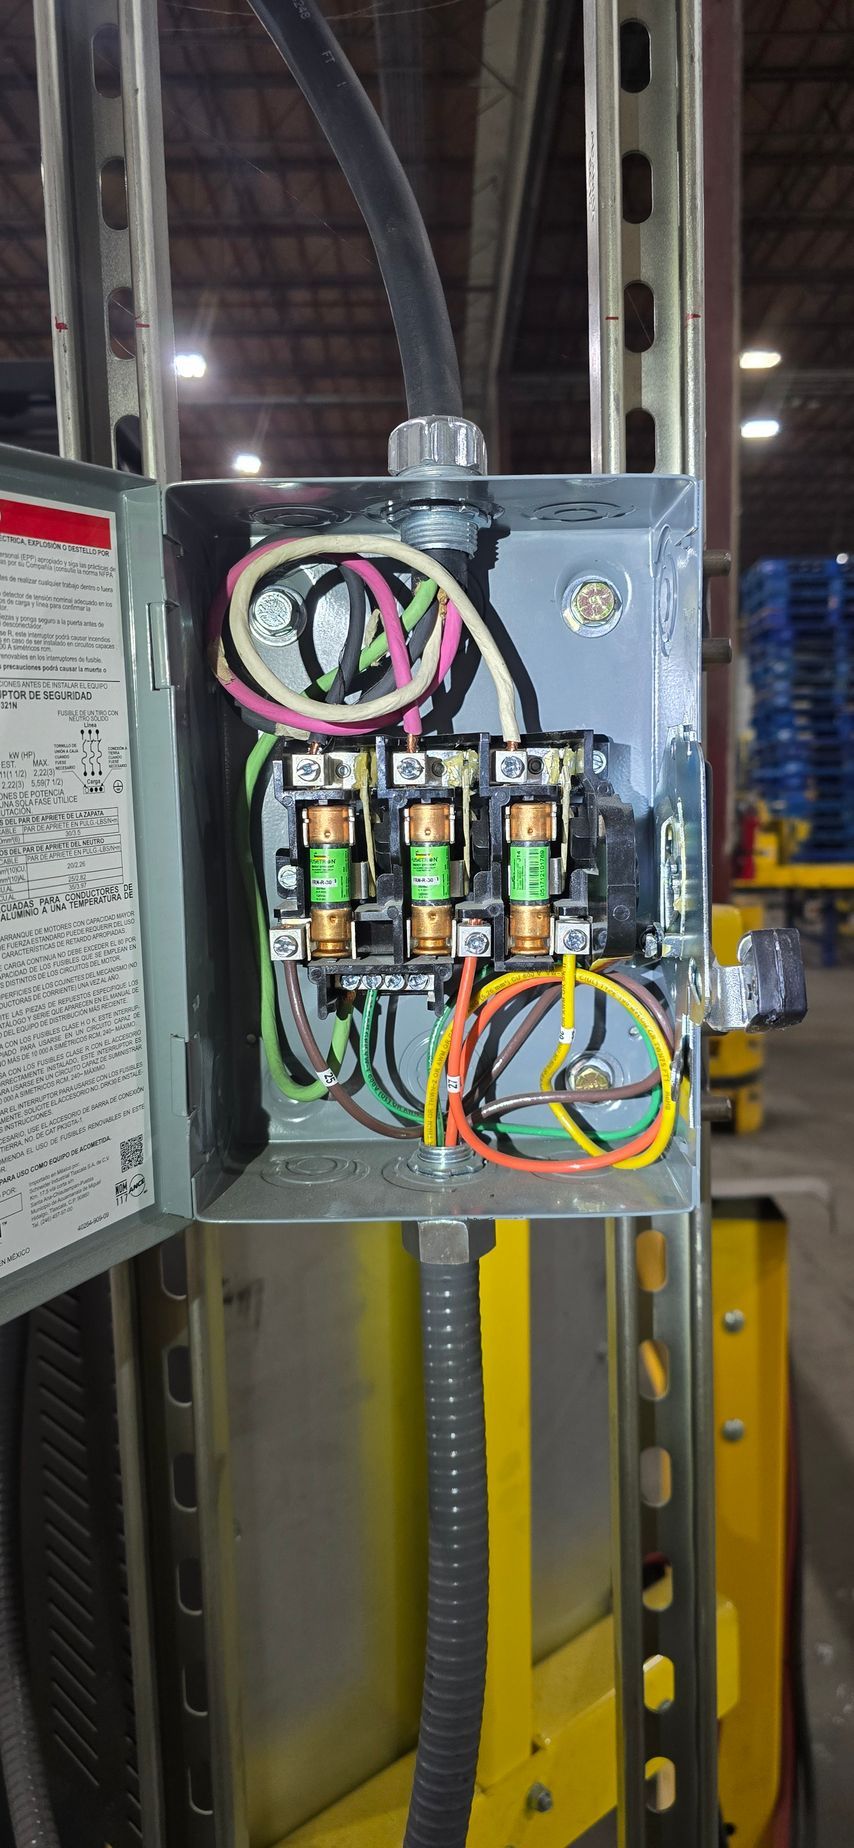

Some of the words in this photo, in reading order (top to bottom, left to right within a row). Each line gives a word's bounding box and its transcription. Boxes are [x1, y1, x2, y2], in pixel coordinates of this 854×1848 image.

[68, 545, 96, 554] DESTELLO
[43, 691, 92, 699] SEGURIDAD
[29, 789, 64, 797] POTENCIA
[0, 900, 34, 912] CUADAS
[40, 895, 60, 905] PARA
[65, 886, 119, 900] CONDUCTORES
[0, 907, 39, 921] ALUMINIO
[51, 902, 66, 912] UNA
[70, 893, 121, 908] TEMPERATURA
[0, 930, 33, 942] ARRANQUE
[44, 923, 72, 933] MOTORES
[86, 914, 115, 924] CAPACIDAD
[4, 961, 25, 970] CARGA
[27, 954, 56, 965] CONTINUA
[84, 942, 109, 952] EXCEDER
[9, 1066, 21, 1075] CON
[23, 1062, 35, 1071] LOS
[37, 1053, 64, 1066] FUSIBLES
[66, 1047, 83, 1057] CLASE
[91, 1041, 103, 1049] CON
[112, 1029, 141, 1042] ACCESORIO
[436, 1052, 446, 1068] AWM
[324, 1072, 336, 1085] 25
[433, 1068, 440, 1078] OR
[429, 1079, 438, 1106] THWN-2
[448, 1078, 458, 1090] 27
[27, 1124, 40, 1134] USE
[48, 1109, 81, 1126] ACCESORIO
[92, 1098, 109, 1110] BARRA
[118, 1085, 144, 1100] CONEXIÓN
[36, 1141, 48, 1150] USO
[60, 1126, 86, 1141] FUSIBLES
[88, 1112, 121, 1130] RENOVABLES
[132, 1103, 144, 1112] ESTE
[17, 1168, 29, 1178] USO
[30, 1160, 48, 1173] COMO
[49, 1152, 70, 1165] EQUIPO
[116, 1194, 128, 1206] 117
[7, 1246, 30, 1263] MÉXICO
